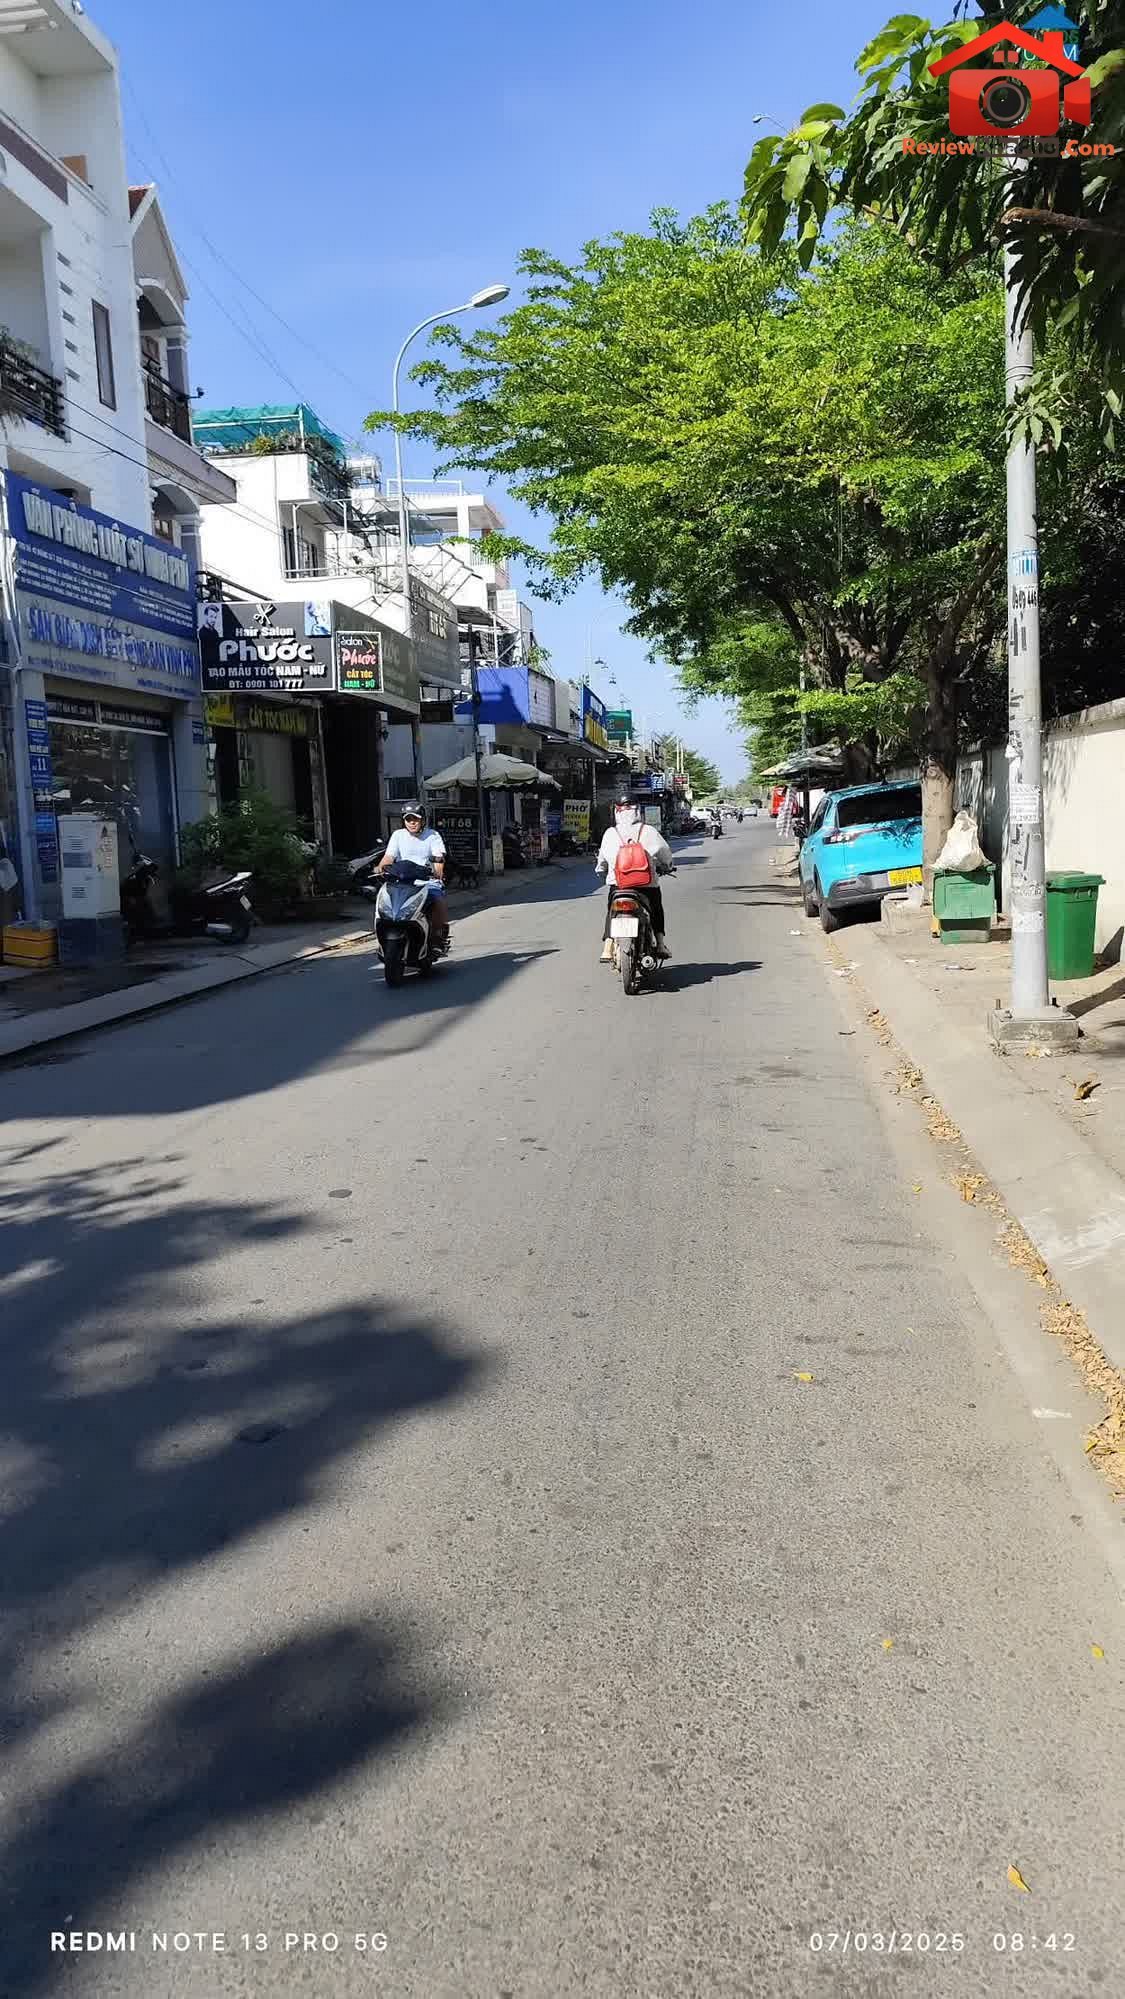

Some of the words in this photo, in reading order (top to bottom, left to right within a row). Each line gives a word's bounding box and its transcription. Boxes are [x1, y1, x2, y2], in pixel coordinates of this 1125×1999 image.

[22, 487, 54, 539] VĂN
[52, 498, 98, 558] PHÒNG
[235, 627, 259, 637] Hair
[260, 626, 294, 637] Salon
[341, 636, 363, 647] Salon
[219, 639, 315, 662] Phước
[341, 648, 377, 665] Phước
[208, 667, 226, 680] TẠO
[255, 665, 274, 677] TÓC
[276, 665, 302, 677] NAM
[310, 662, 327, 677] NỮ
[566, 802, 588, 813] PHỞ
